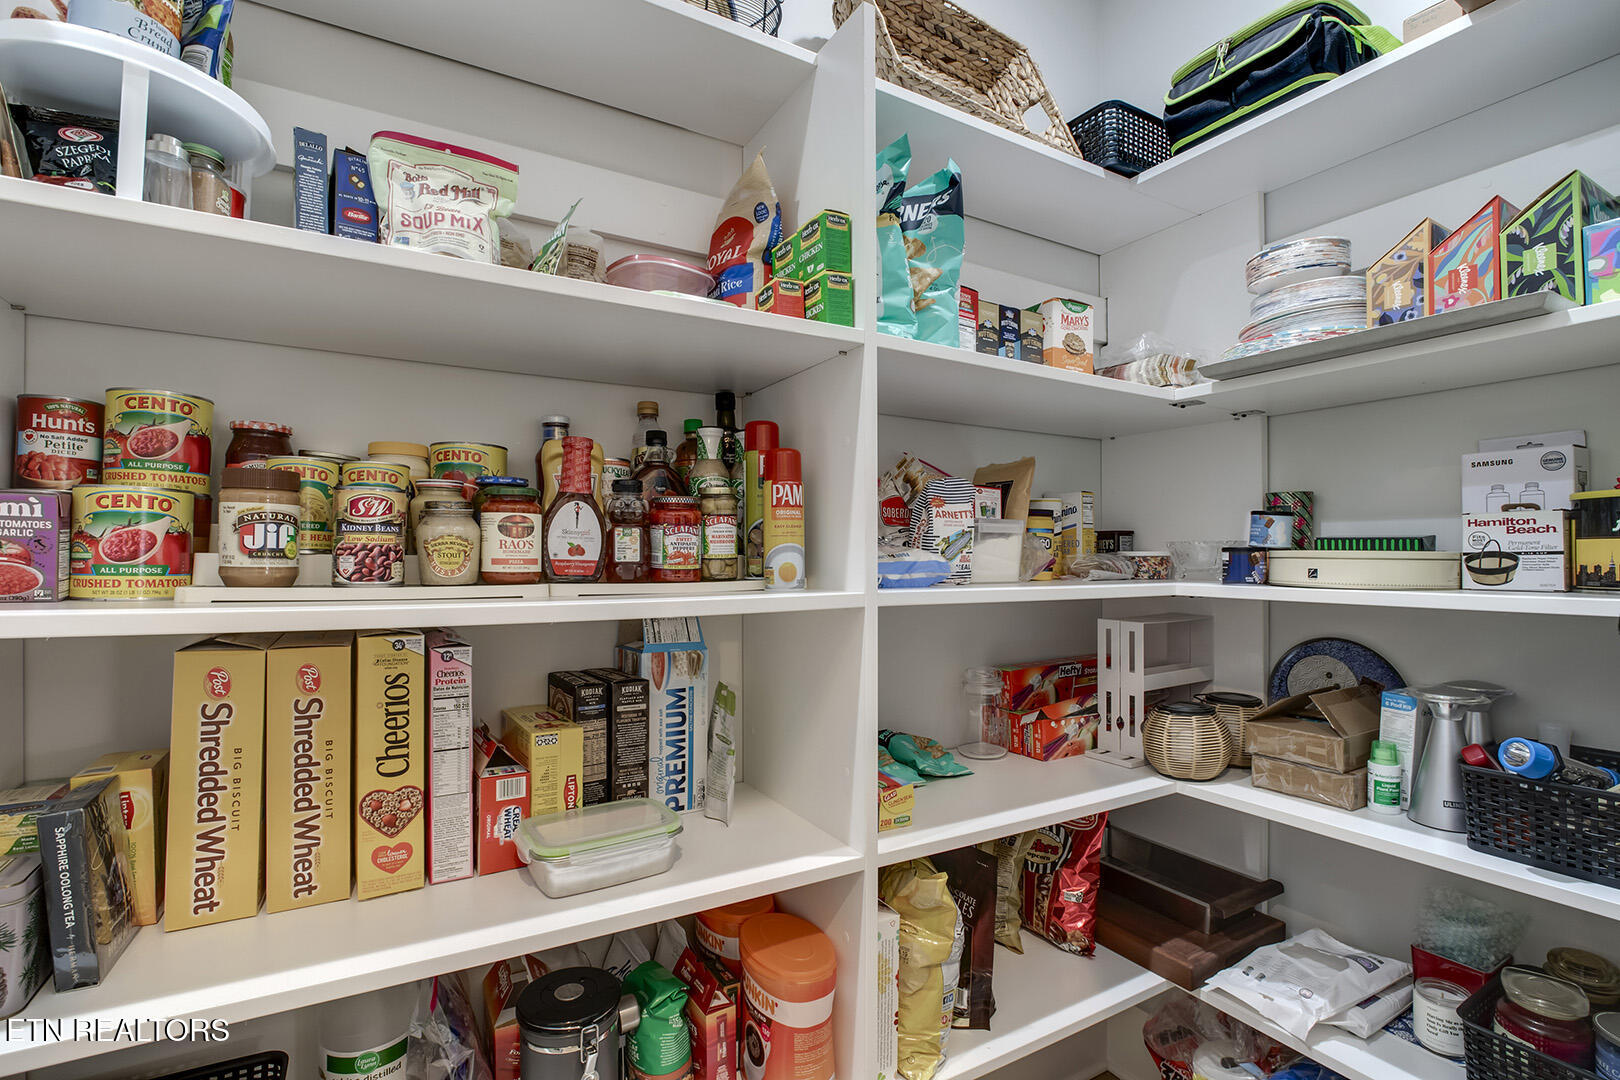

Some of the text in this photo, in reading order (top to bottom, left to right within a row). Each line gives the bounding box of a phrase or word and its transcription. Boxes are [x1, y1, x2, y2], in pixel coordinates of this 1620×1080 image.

[135, 17, 174, 49] Bread
[56, 144, 111, 157] SZEGEDI
[403, 172, 429, 182] Bob's
[418, 183, 481, 200] Red Mill
[347, 212, 369, 220] Barilla
[401, 212, 484, 236] SOUP MIX
[799, 242, 823, 263] CHICKEN
[1533, 241, 1548, 276] Kleenex
[1458, 262, 1473, 295] Kleenex
[721, 279, 743, 293] Rice
[1391, 281, 1402, 311] Kleenex
[1061, 313, 1089, 327] MARY'S
[124, 396, 194, 416] CENTO
[44, 440, 84, 452] Petite
[67, 436, 89, 444] Added
[436, 450, 483, 463] CENTO
[145, 462, 185, 471] PURPOSE
[1471, 459, 1514, 468] SAMSUNG
[348, 471, 399, 484] CENTO
[602, 466, 621, 476] UCKY
[104, 471, 147, 482] CRUSHED
[150, 473, 207, 487] TOMATOES
[772, 484, 804, 506] PAM
[96, 494, 173, 513] CENTO
[352, 497, 392, 518] S&W
[243, 513, 295, 523] NATURAL
[706, 516, 737, 526] SCLAFAN
[1467, 518, 1537, 528] Hamilton
[0, 520, 53, 530] TOMATOES
[341, 524, 400, 534] KIDNEY BEANS
[665, 525, 697, 536] SCLAFAN
[1506, 525, 1557, 534] Beach
[243, 523, 295, 550] Jif
[365, 535, 395, 543] Sodium
[499, 540, 535, 550] RAO'S
[119, 567, 164, 575] PURPOSE
[72, 578, 188, 589] CRUSHED TOMATOES
[437, 669, 465, 678] Cheerios
[1059, 665, 1082, 678] Hefty
[212, 669, 229, 696] Post
[303, 666, 320, 692] Post
[435, 678, 467, 690] Protein
[581, 688, 604, 696] KODIAK
[621, 685, 643, 694] KODIAK
[375, 672, 411, 779] Cheerios
[664, 688, 687, 814] PREMIUM
[325, 740, 334, 820] BIG BISCUIT
[231, 747, 244, 832] BIG BISCUIT
[567, 775, 576, 809] LIPTON
[883, 791, 898, 801] GLAD
[293, 698, 324, 899] Shredded Wheat
[193, 702, 234, 917] Shredded Wheat
[504, 808, 514, 840] WHEAT
[880, 819, 892, 827] 200
[377, 855, 409, 864] CHOLESTEROL
[55, 826, 76, 928] SAPPHIRE OOLONG TEA
[363, 1061, 403, 1080] distilled
